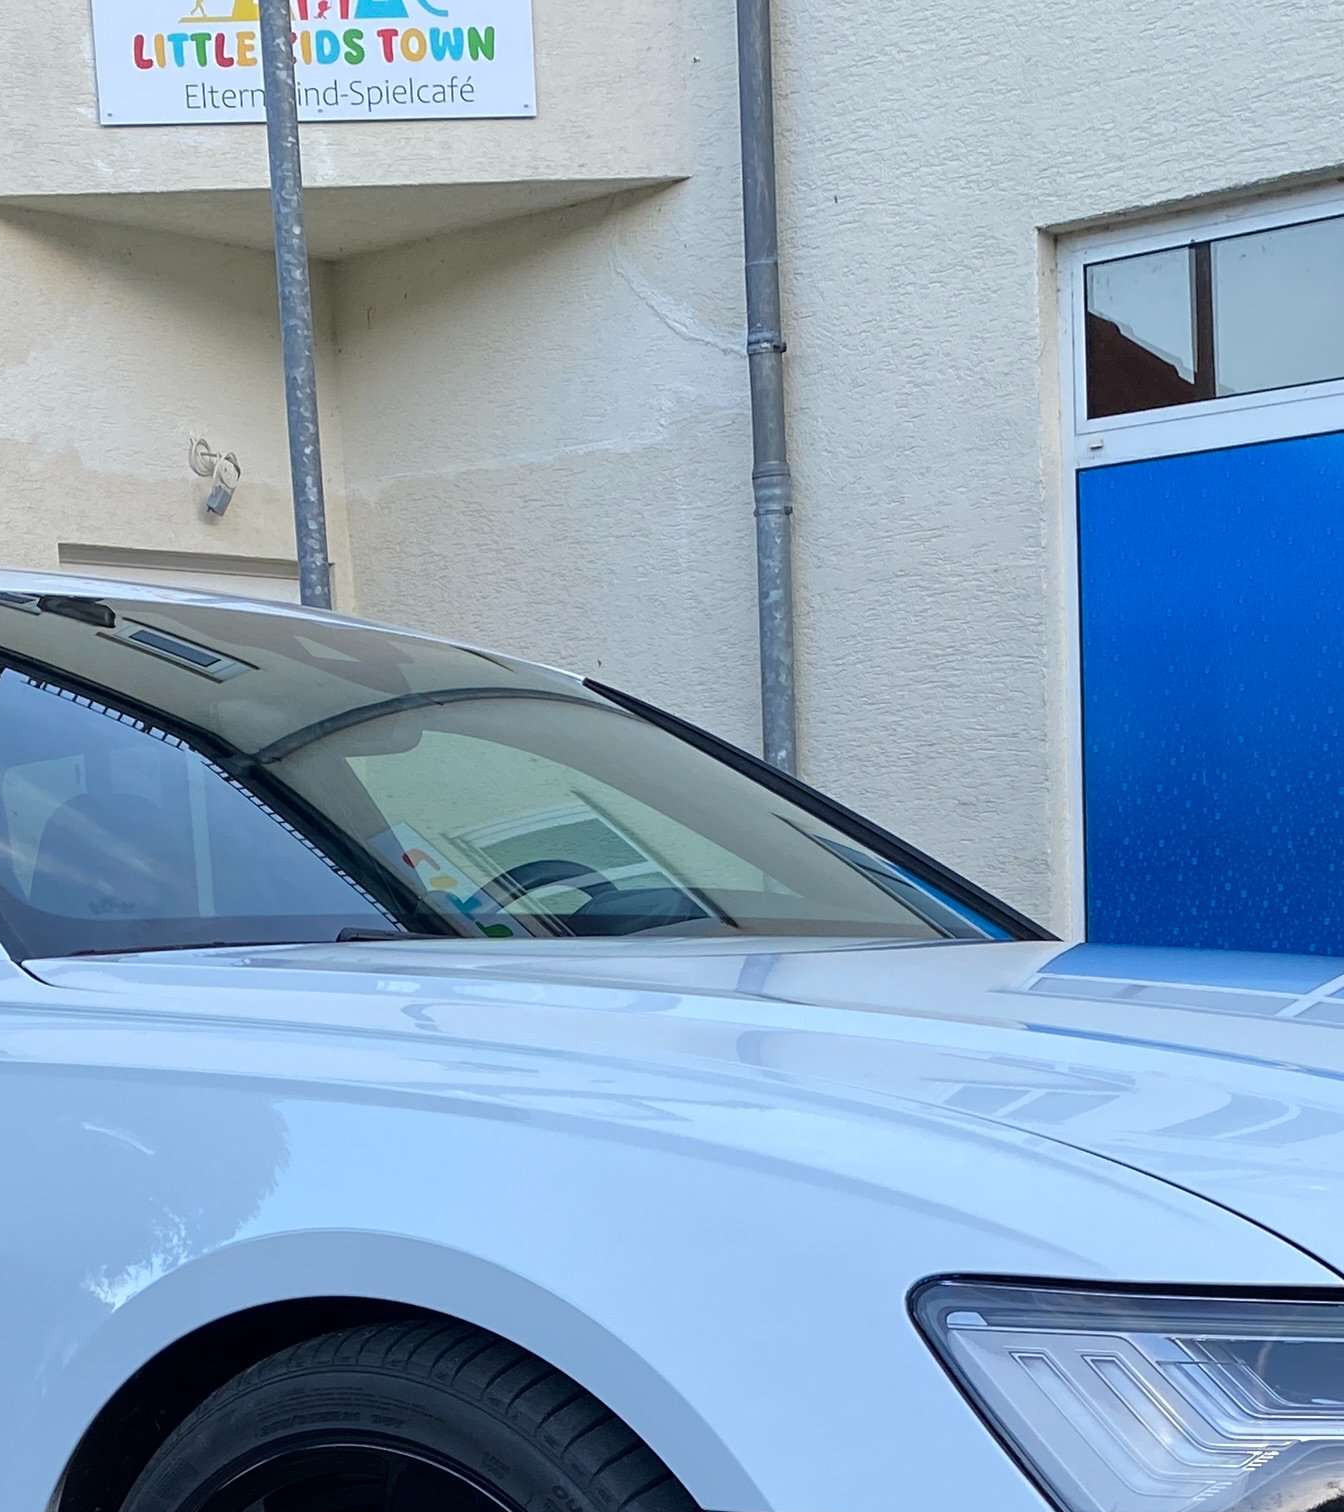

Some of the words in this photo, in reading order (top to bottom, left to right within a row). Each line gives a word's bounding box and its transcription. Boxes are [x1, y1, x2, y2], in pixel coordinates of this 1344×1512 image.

[133, 30, 258, 70] LITTLE
[288, 26, 366, 66] IDS
[376, 26, 495, 64] TOWN
